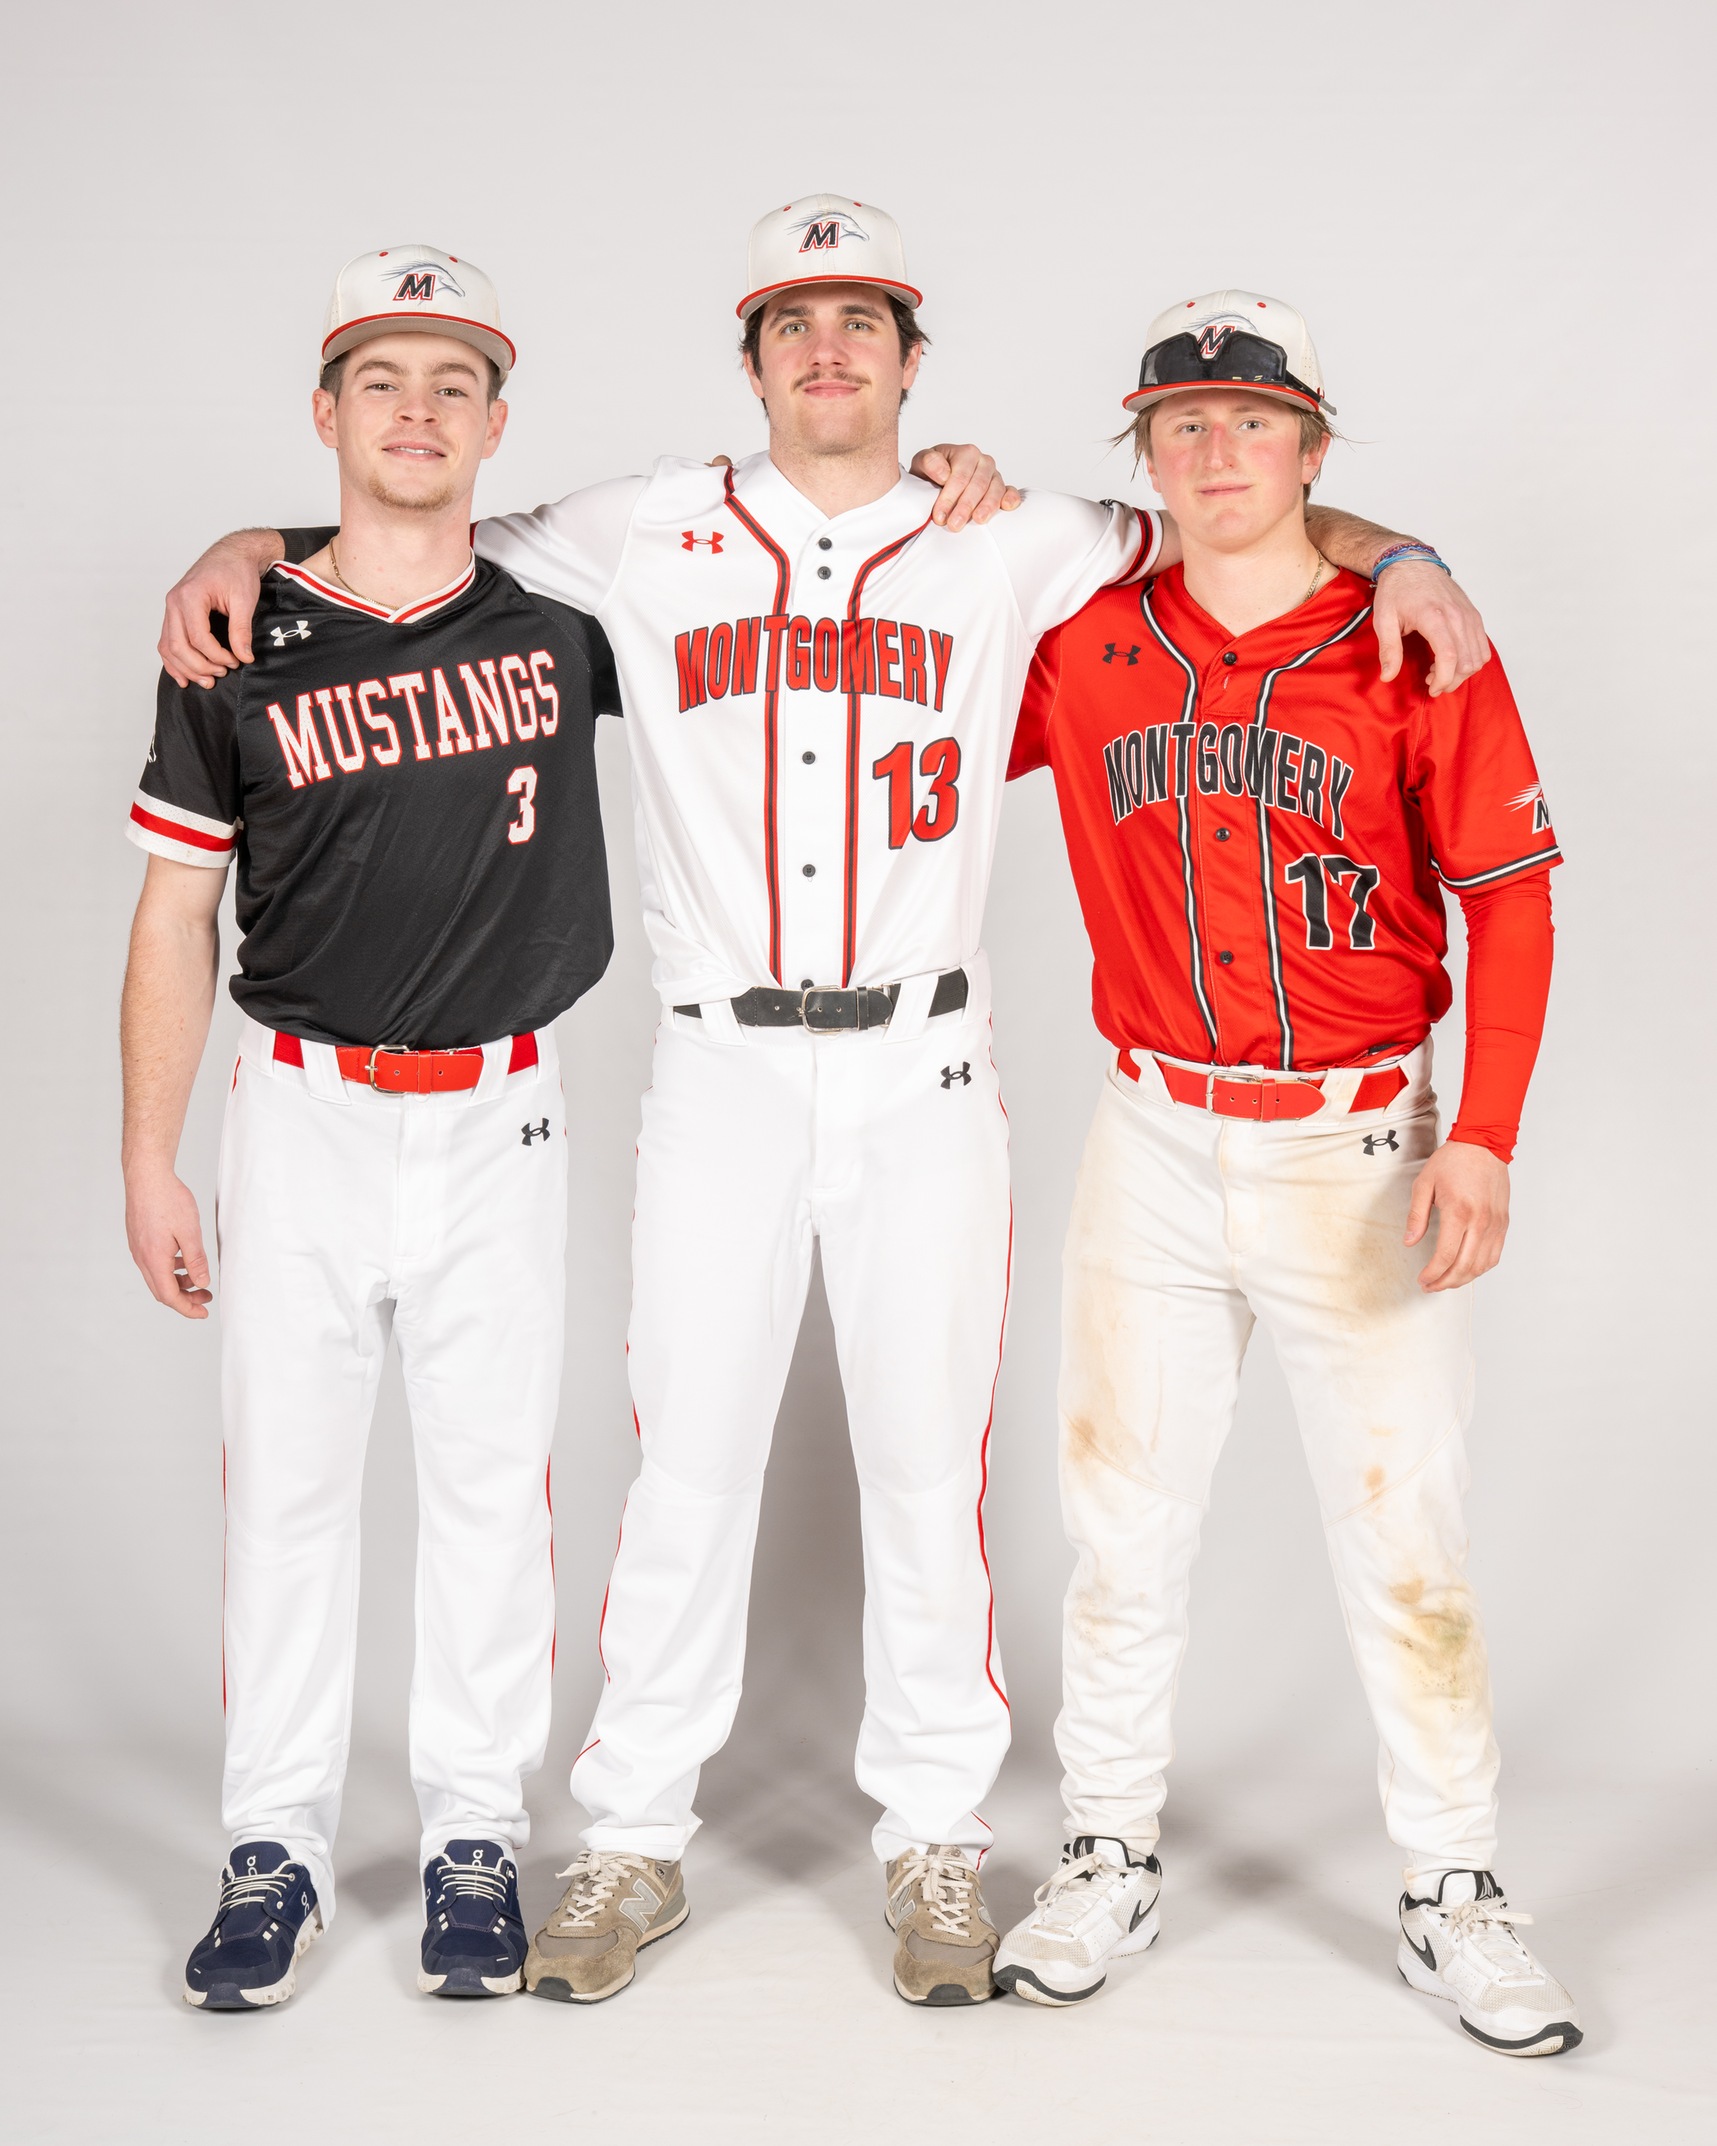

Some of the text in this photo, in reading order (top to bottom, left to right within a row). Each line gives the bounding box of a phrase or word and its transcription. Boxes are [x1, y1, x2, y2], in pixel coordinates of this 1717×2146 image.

[392, 273, 436, 301] M
[798, 221, 840, 254] M
[1197, 325, 1235, 354] M
[674, 613, 953, 713] MONTGOMERY
[265, 650, 560, 790] MUSTANGS
[507, 765, 538, 845] 3
[872, 736, 962, 850] 13
[1103, 721, 1354, 840] MONTGOMERY
[1285, 852, 1378, 951] 17
